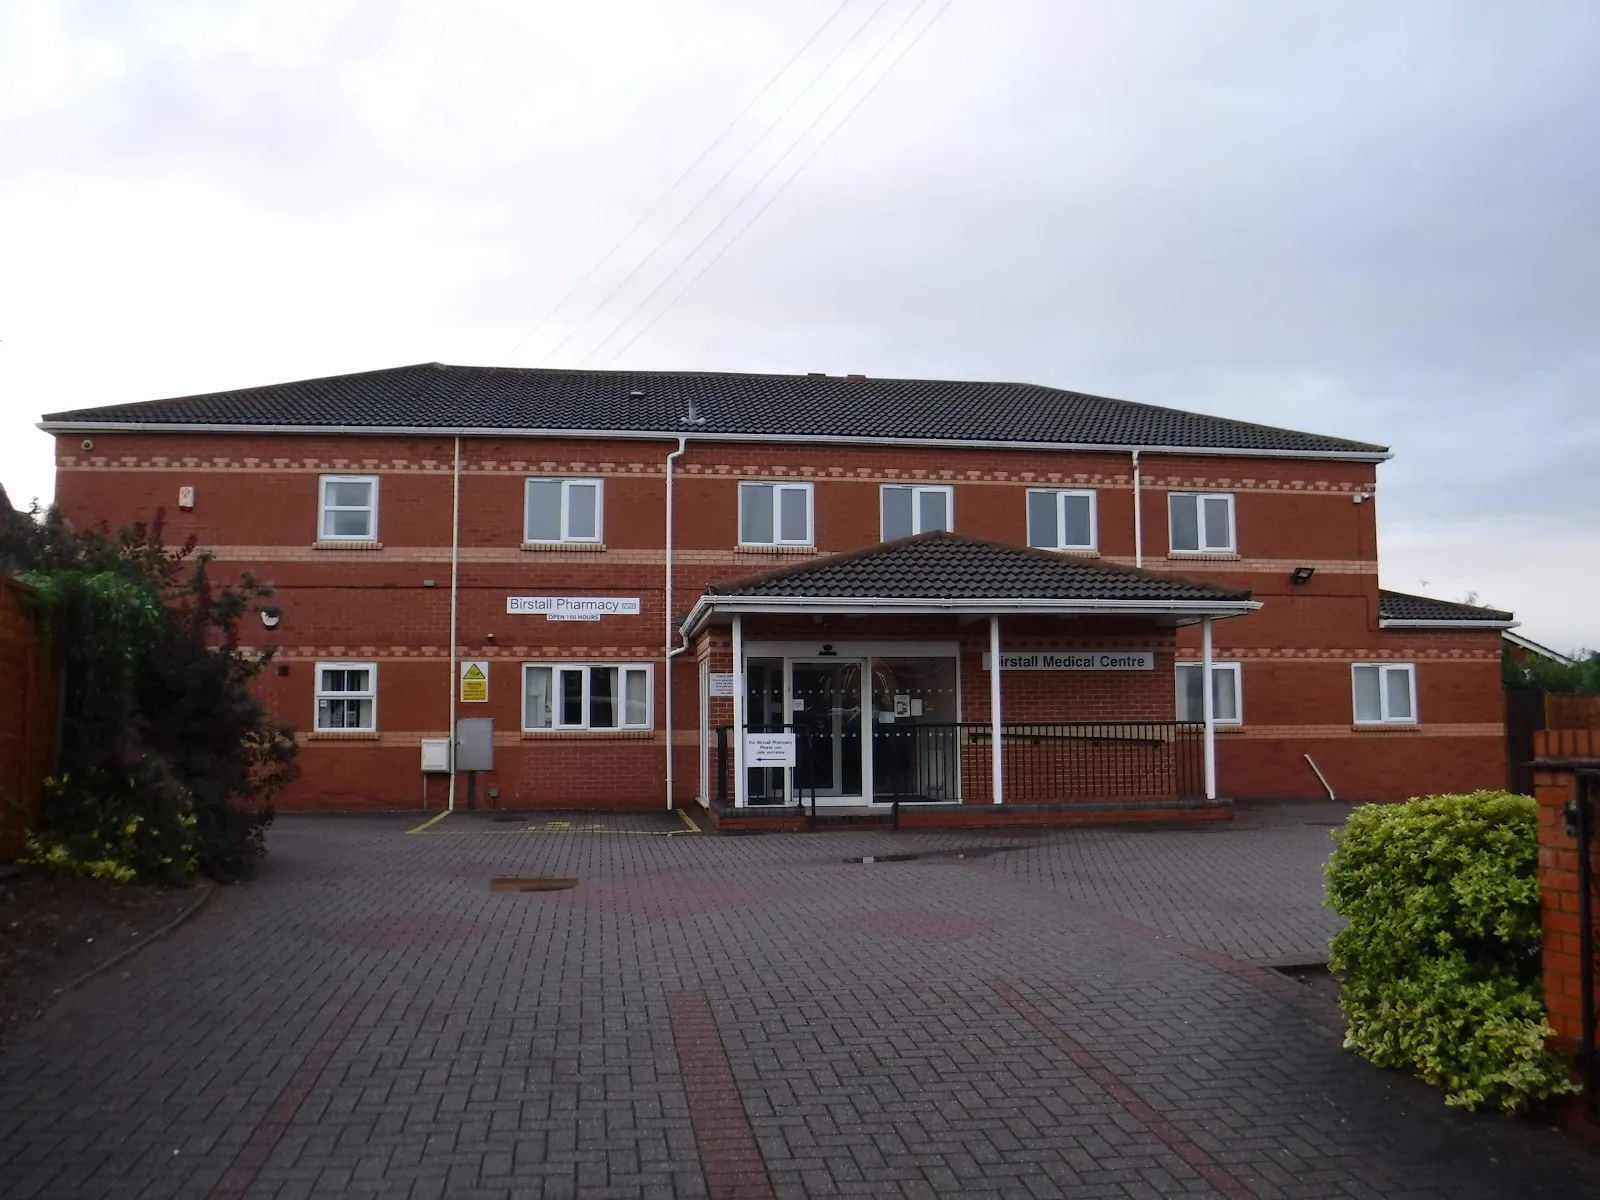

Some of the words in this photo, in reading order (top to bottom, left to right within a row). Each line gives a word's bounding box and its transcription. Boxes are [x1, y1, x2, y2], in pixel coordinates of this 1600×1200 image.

[510, 598, 552, 610] Birstall
[556, 598, 619, 612] Pharmacy
[998, 655, 1038, 667] irstall
[1043, 655, 1095, 667] Medical
[1100, 656, 1145, 667] Centre
